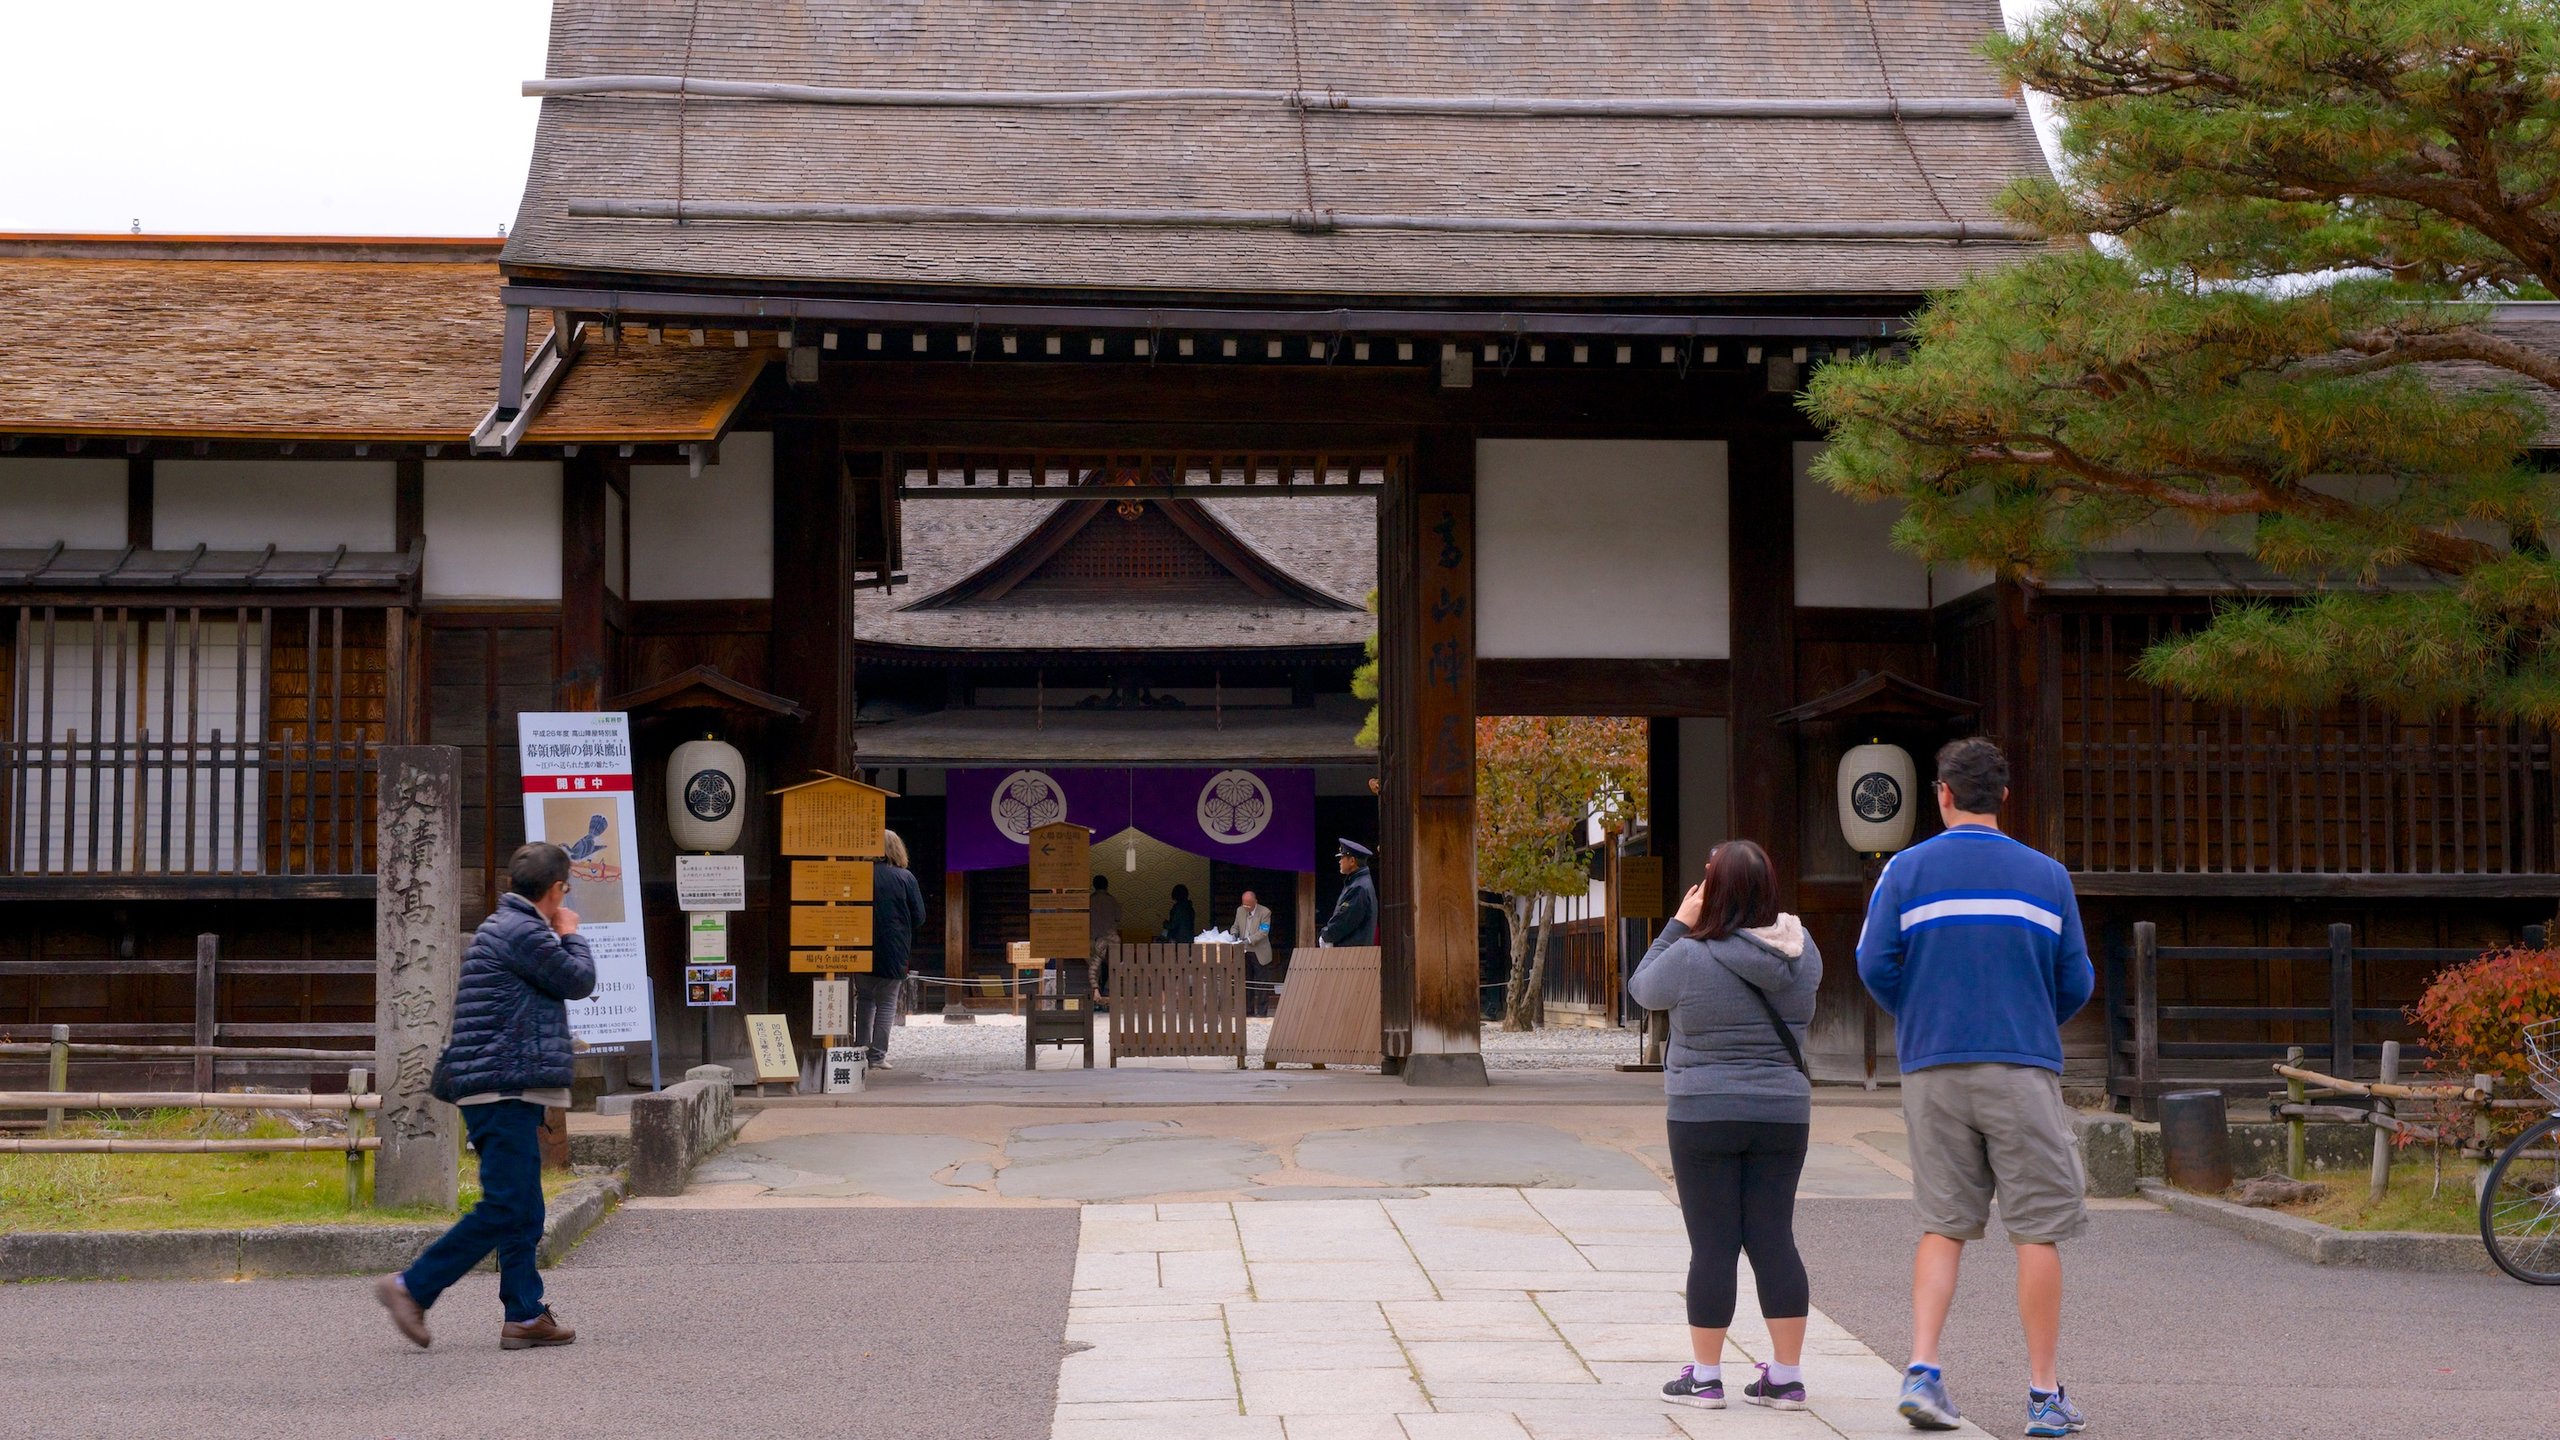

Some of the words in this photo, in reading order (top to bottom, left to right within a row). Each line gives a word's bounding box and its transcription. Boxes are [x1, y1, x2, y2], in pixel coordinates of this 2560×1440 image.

[532, 730, 570, 738] 平成26年度
[556, 777, 603, 790] 開催中
[771, 1023, 787, 1066] 凹凸があります
